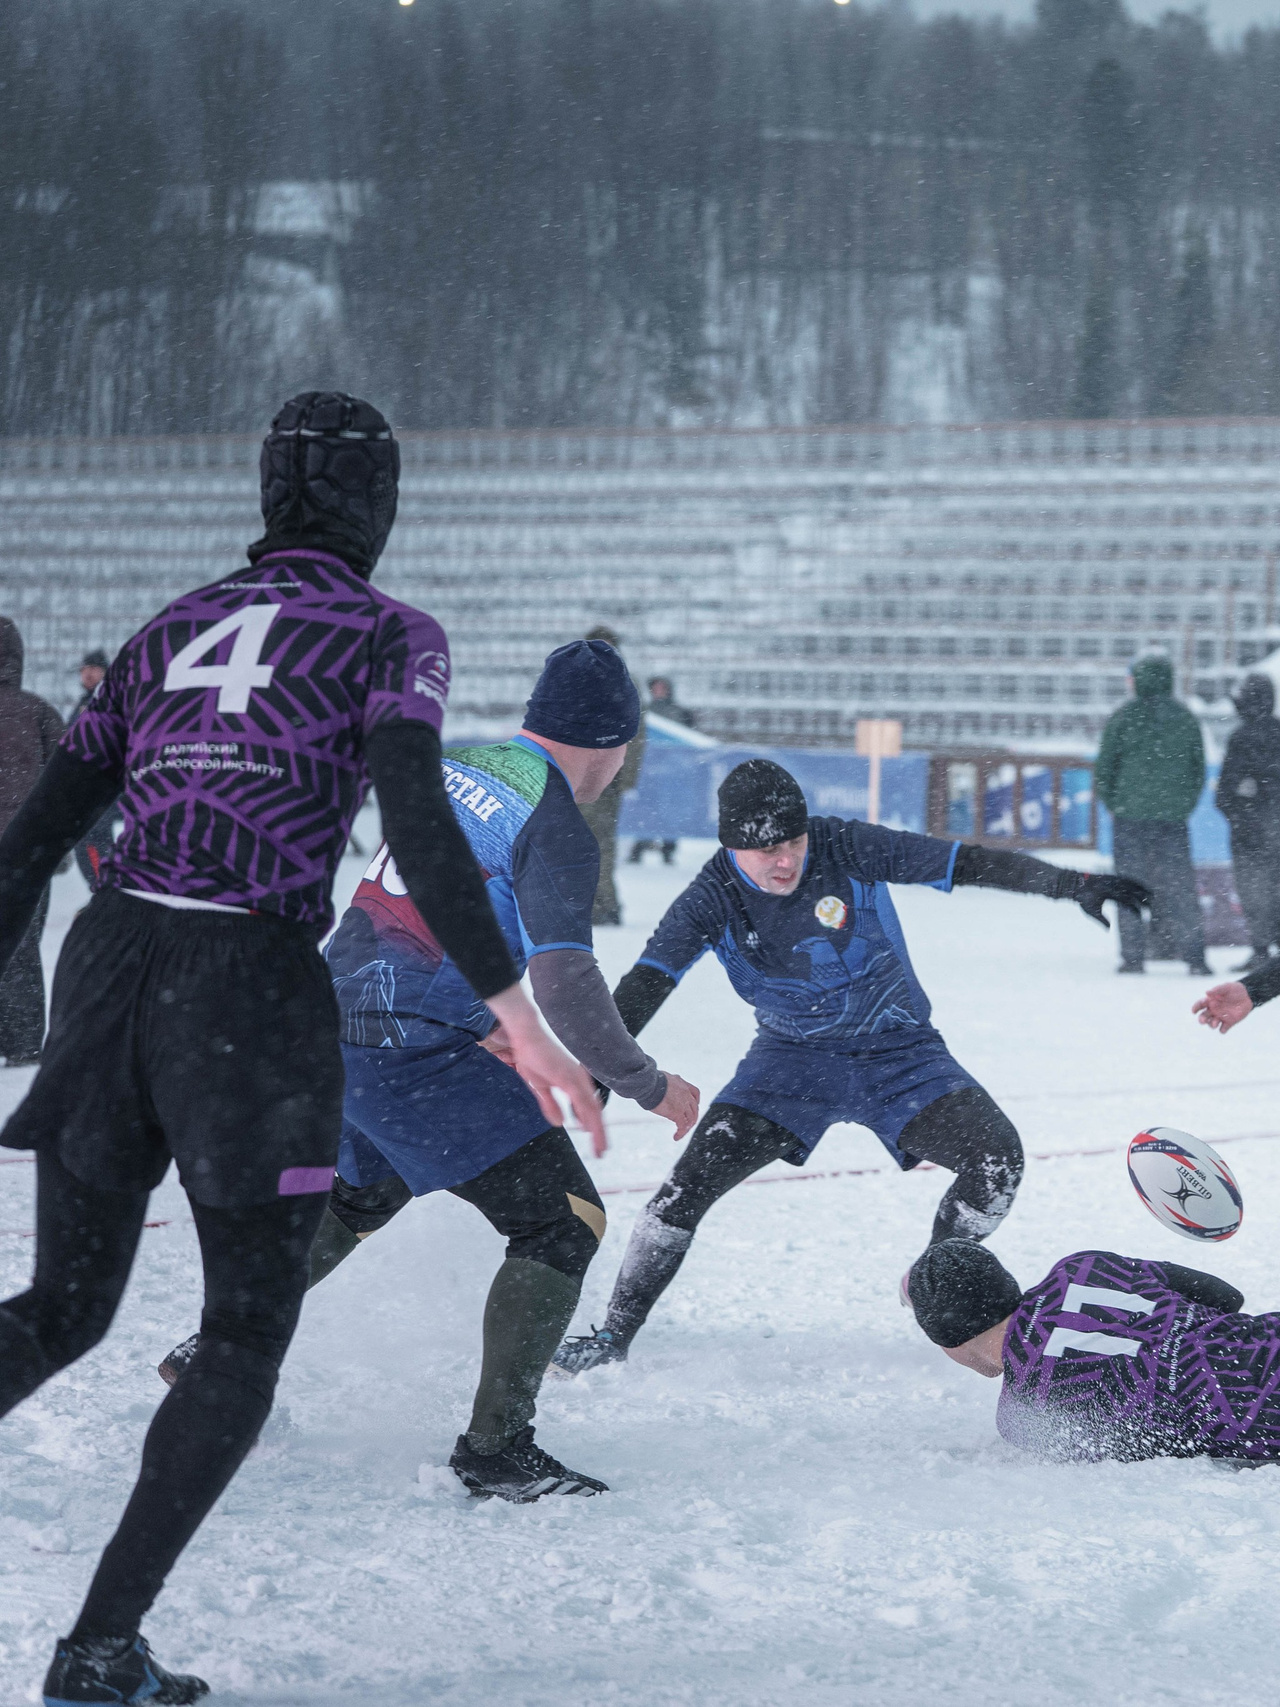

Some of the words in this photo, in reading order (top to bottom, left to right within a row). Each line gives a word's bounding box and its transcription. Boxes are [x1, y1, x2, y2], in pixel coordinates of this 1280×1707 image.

[163, 603, 282, 714] 4
[222, 759, 285, 778] ИНСТИТУТ
[1176, 1166, 1212, 1200] GILBERT
[1043, 1283, 1158, 1358] 11
